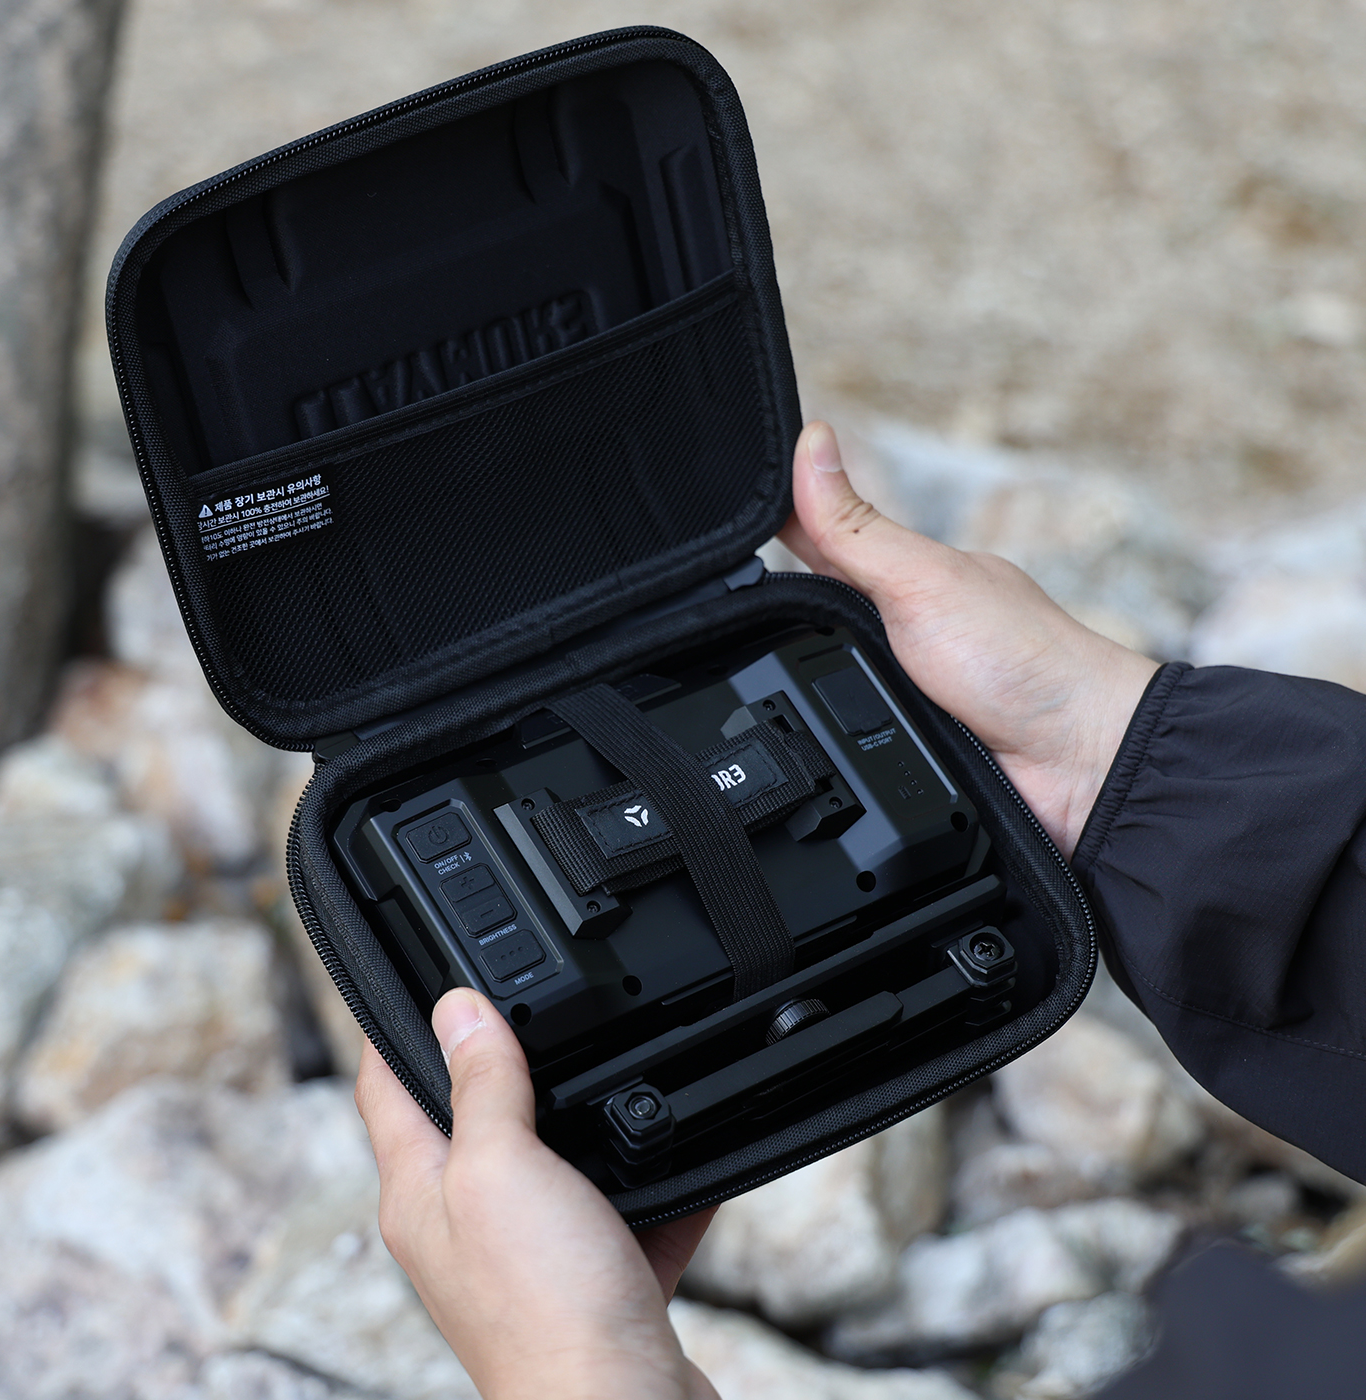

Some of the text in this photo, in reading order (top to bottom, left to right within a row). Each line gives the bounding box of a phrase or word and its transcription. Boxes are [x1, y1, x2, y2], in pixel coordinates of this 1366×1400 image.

[215, 474, 321, 512] 제품 장기 보관시 유의사항
[218, 512, 239, 523] 보관시
[242, 506, 262, 517] 100%
[263, 498, 292, 513] 충전하여
[293, 485, 329, 504] 보관하세요!
[202, 532, 223, 543] 하10도
[204, 541, 217, 551] 터리
[860, 736, 893, 752] USB-C PORT
[434, 854, 459, 869] ON/OFF
[438, 862, 460, 876] CHECK
[478, 924, 518, 946] BRIGHTNESS
[514, 971, 534, 986] MODE
